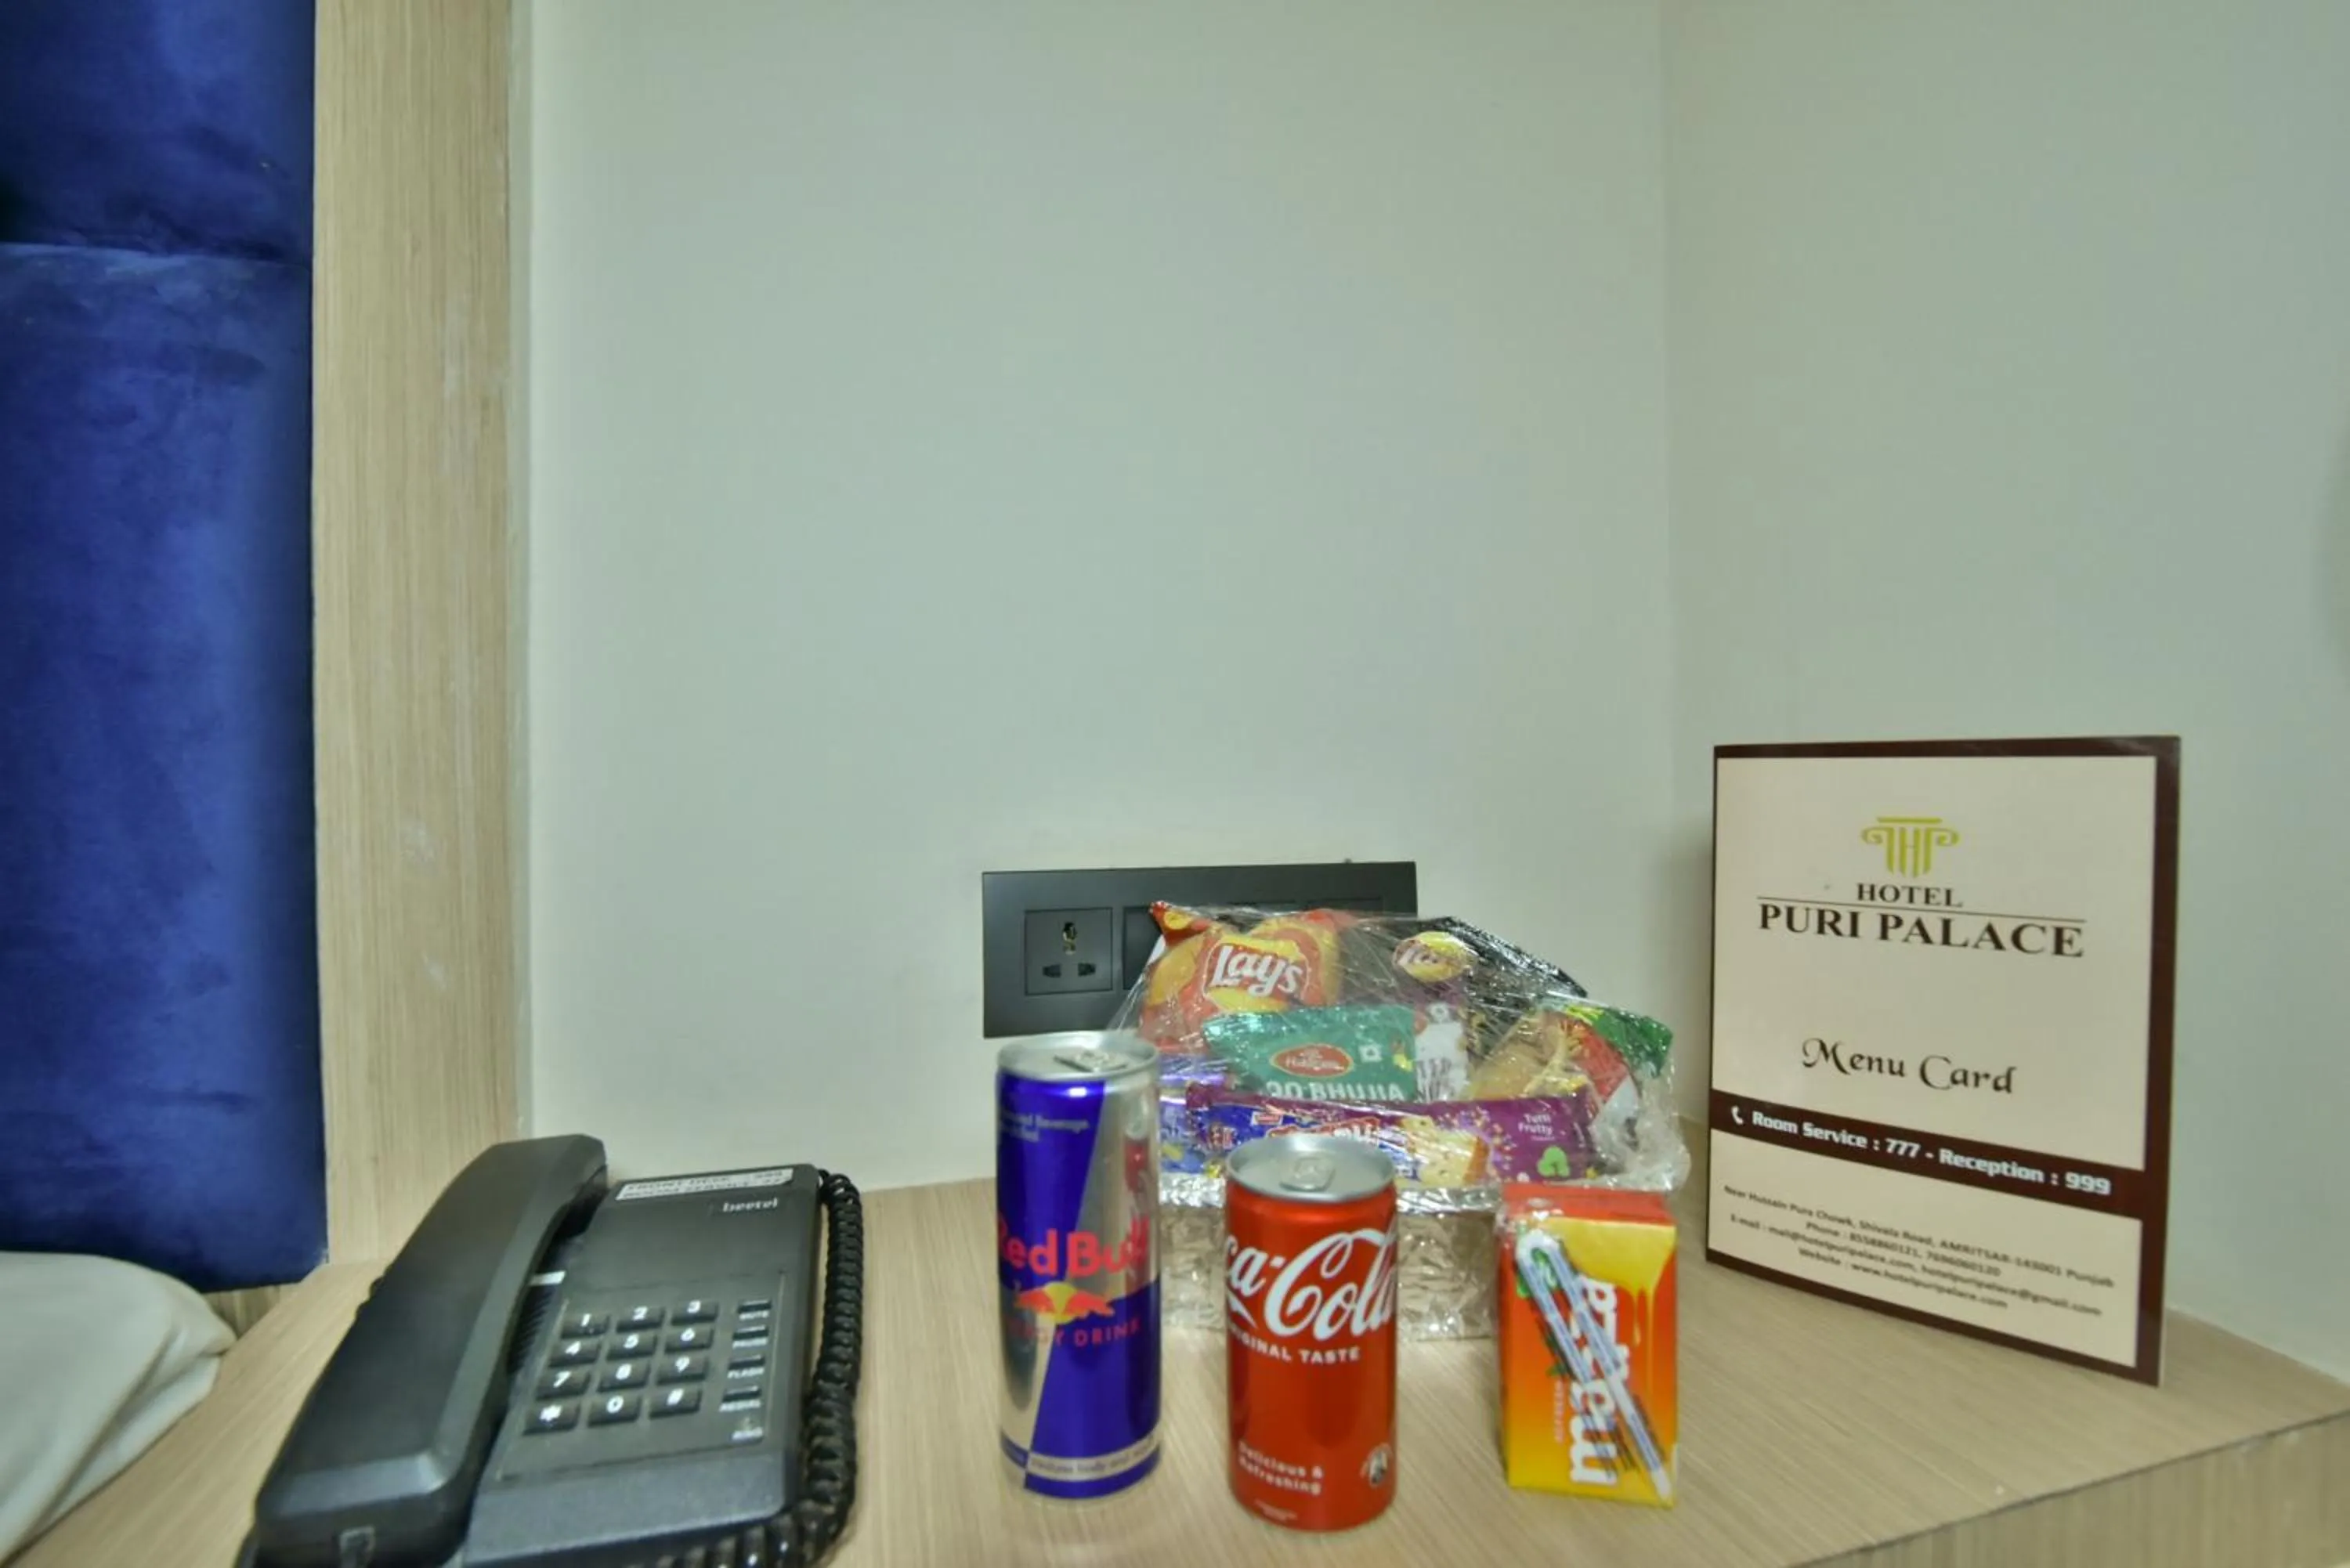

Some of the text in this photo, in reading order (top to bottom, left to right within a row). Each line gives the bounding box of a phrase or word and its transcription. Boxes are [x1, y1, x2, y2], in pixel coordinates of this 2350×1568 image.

[1856, 883, 1964, 909] HOTEL
[1758, 902, 2085, 958] PURI PALACE
[1800, 1037, 2016, 1095] Menu Card
[1752, 1111, 1799, 1134] Room
[1802, 1122, 1868, 1149] Service
[1885, 1137, 1921, 1158] 777
[1939, 1148, 2044, 1183] Reception
[2065, 1172, 2112, 1196] 999
[632, 1306, 647, 1321] 2
[1298, 1347, 1360, 1364] TASTE
[607, 1395, 624, 1413] 0
